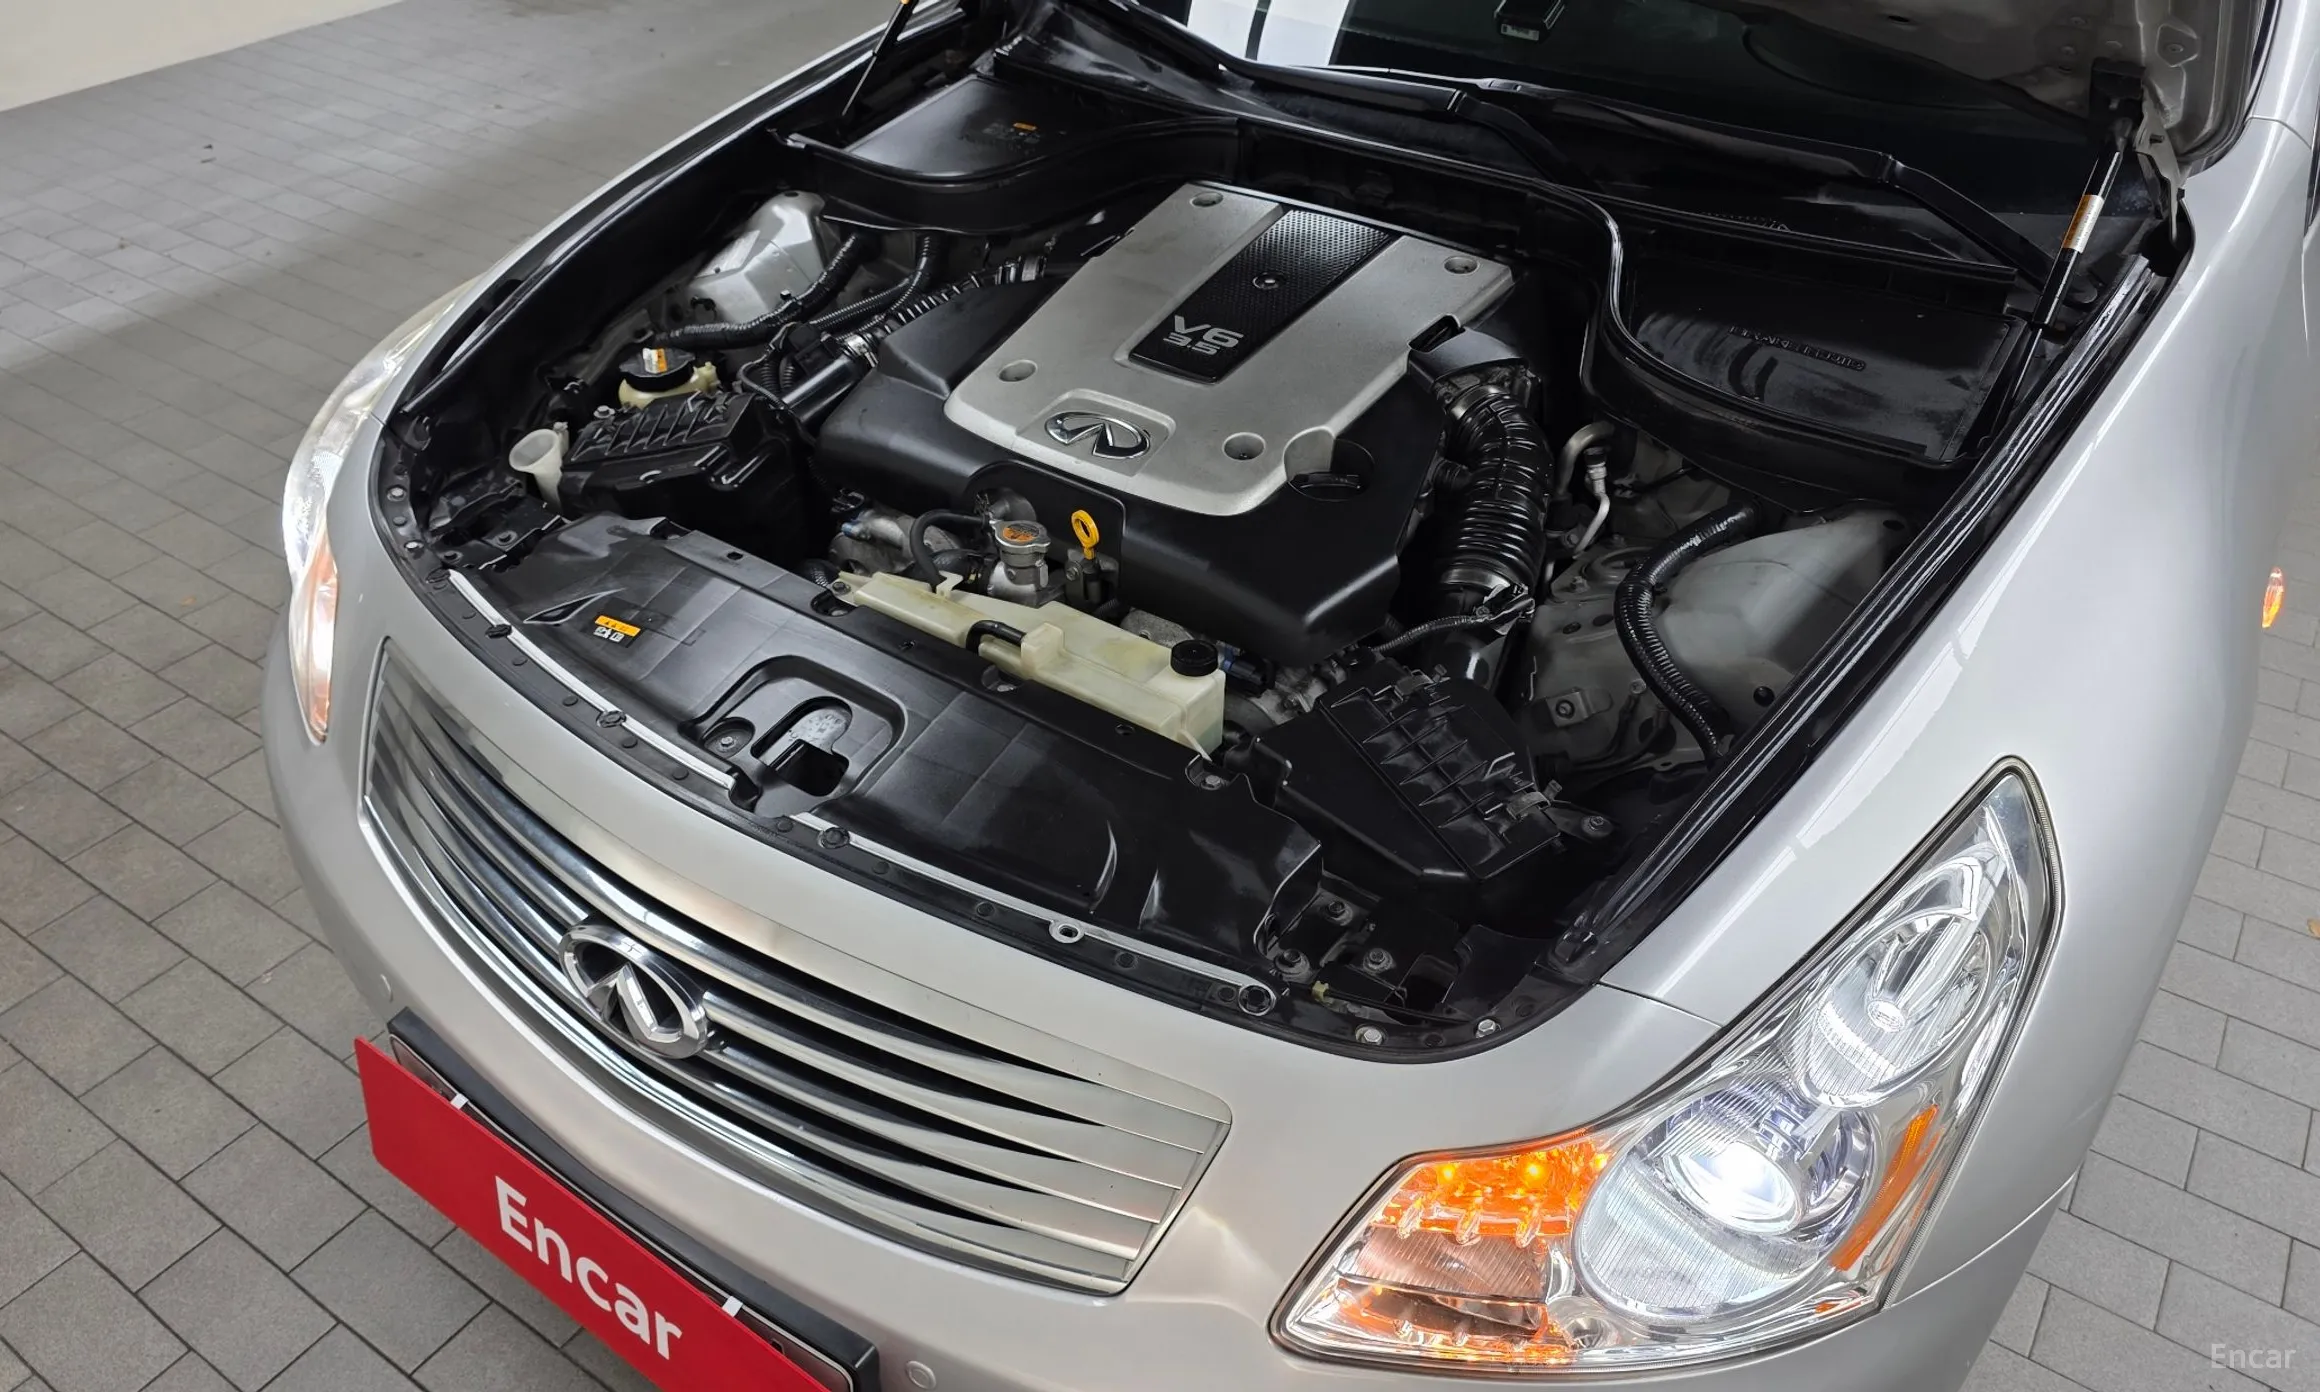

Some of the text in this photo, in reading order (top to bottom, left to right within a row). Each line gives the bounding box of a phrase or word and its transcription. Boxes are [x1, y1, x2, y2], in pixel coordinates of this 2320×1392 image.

[1162, 331, 1221, 355] 3.5
[1174, 314, 1244, 348] V6
[495, 1175, 682, 1360] Encar
